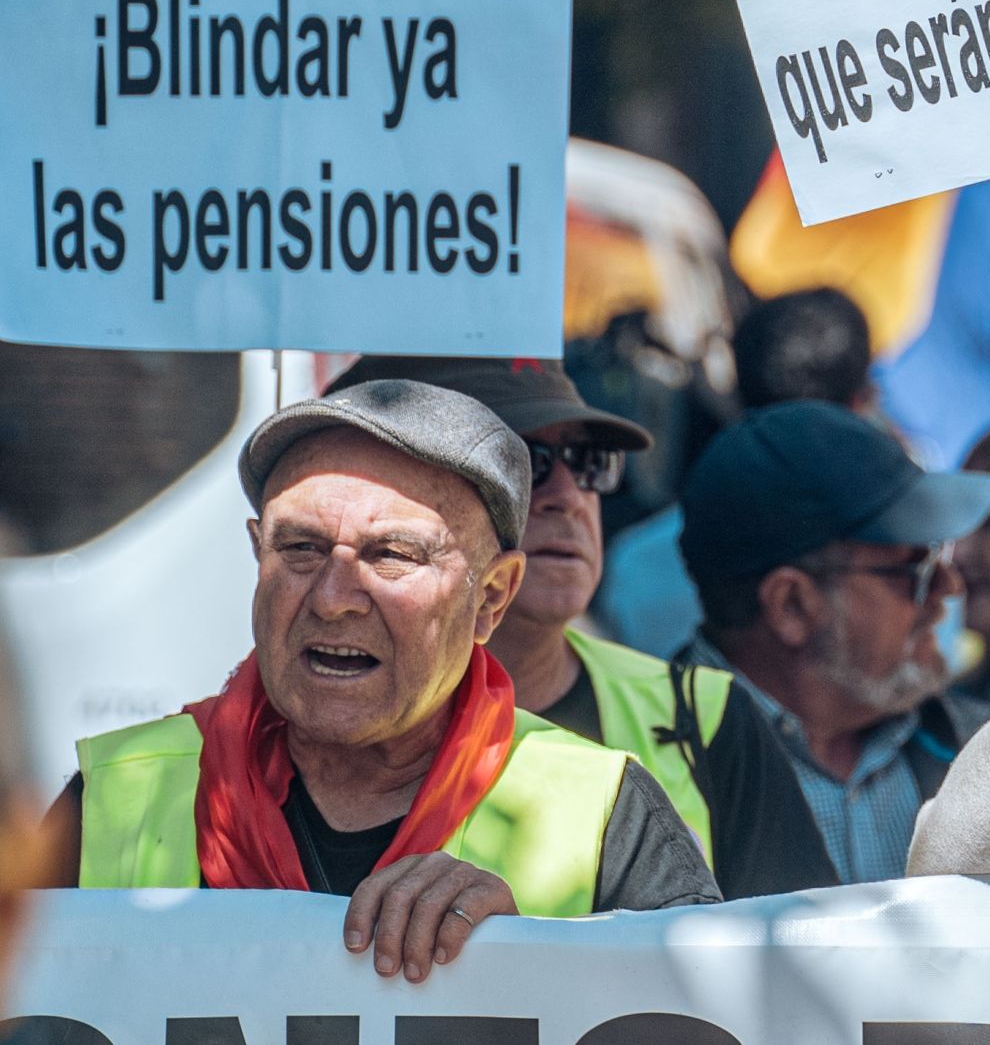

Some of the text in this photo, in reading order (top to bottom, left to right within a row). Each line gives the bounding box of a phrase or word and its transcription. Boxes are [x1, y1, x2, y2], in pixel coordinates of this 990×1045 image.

[382, 17, 459, 130] ya
[774, 37, 874, 164] que
[32, 159, 520, 302] las pensiones!
